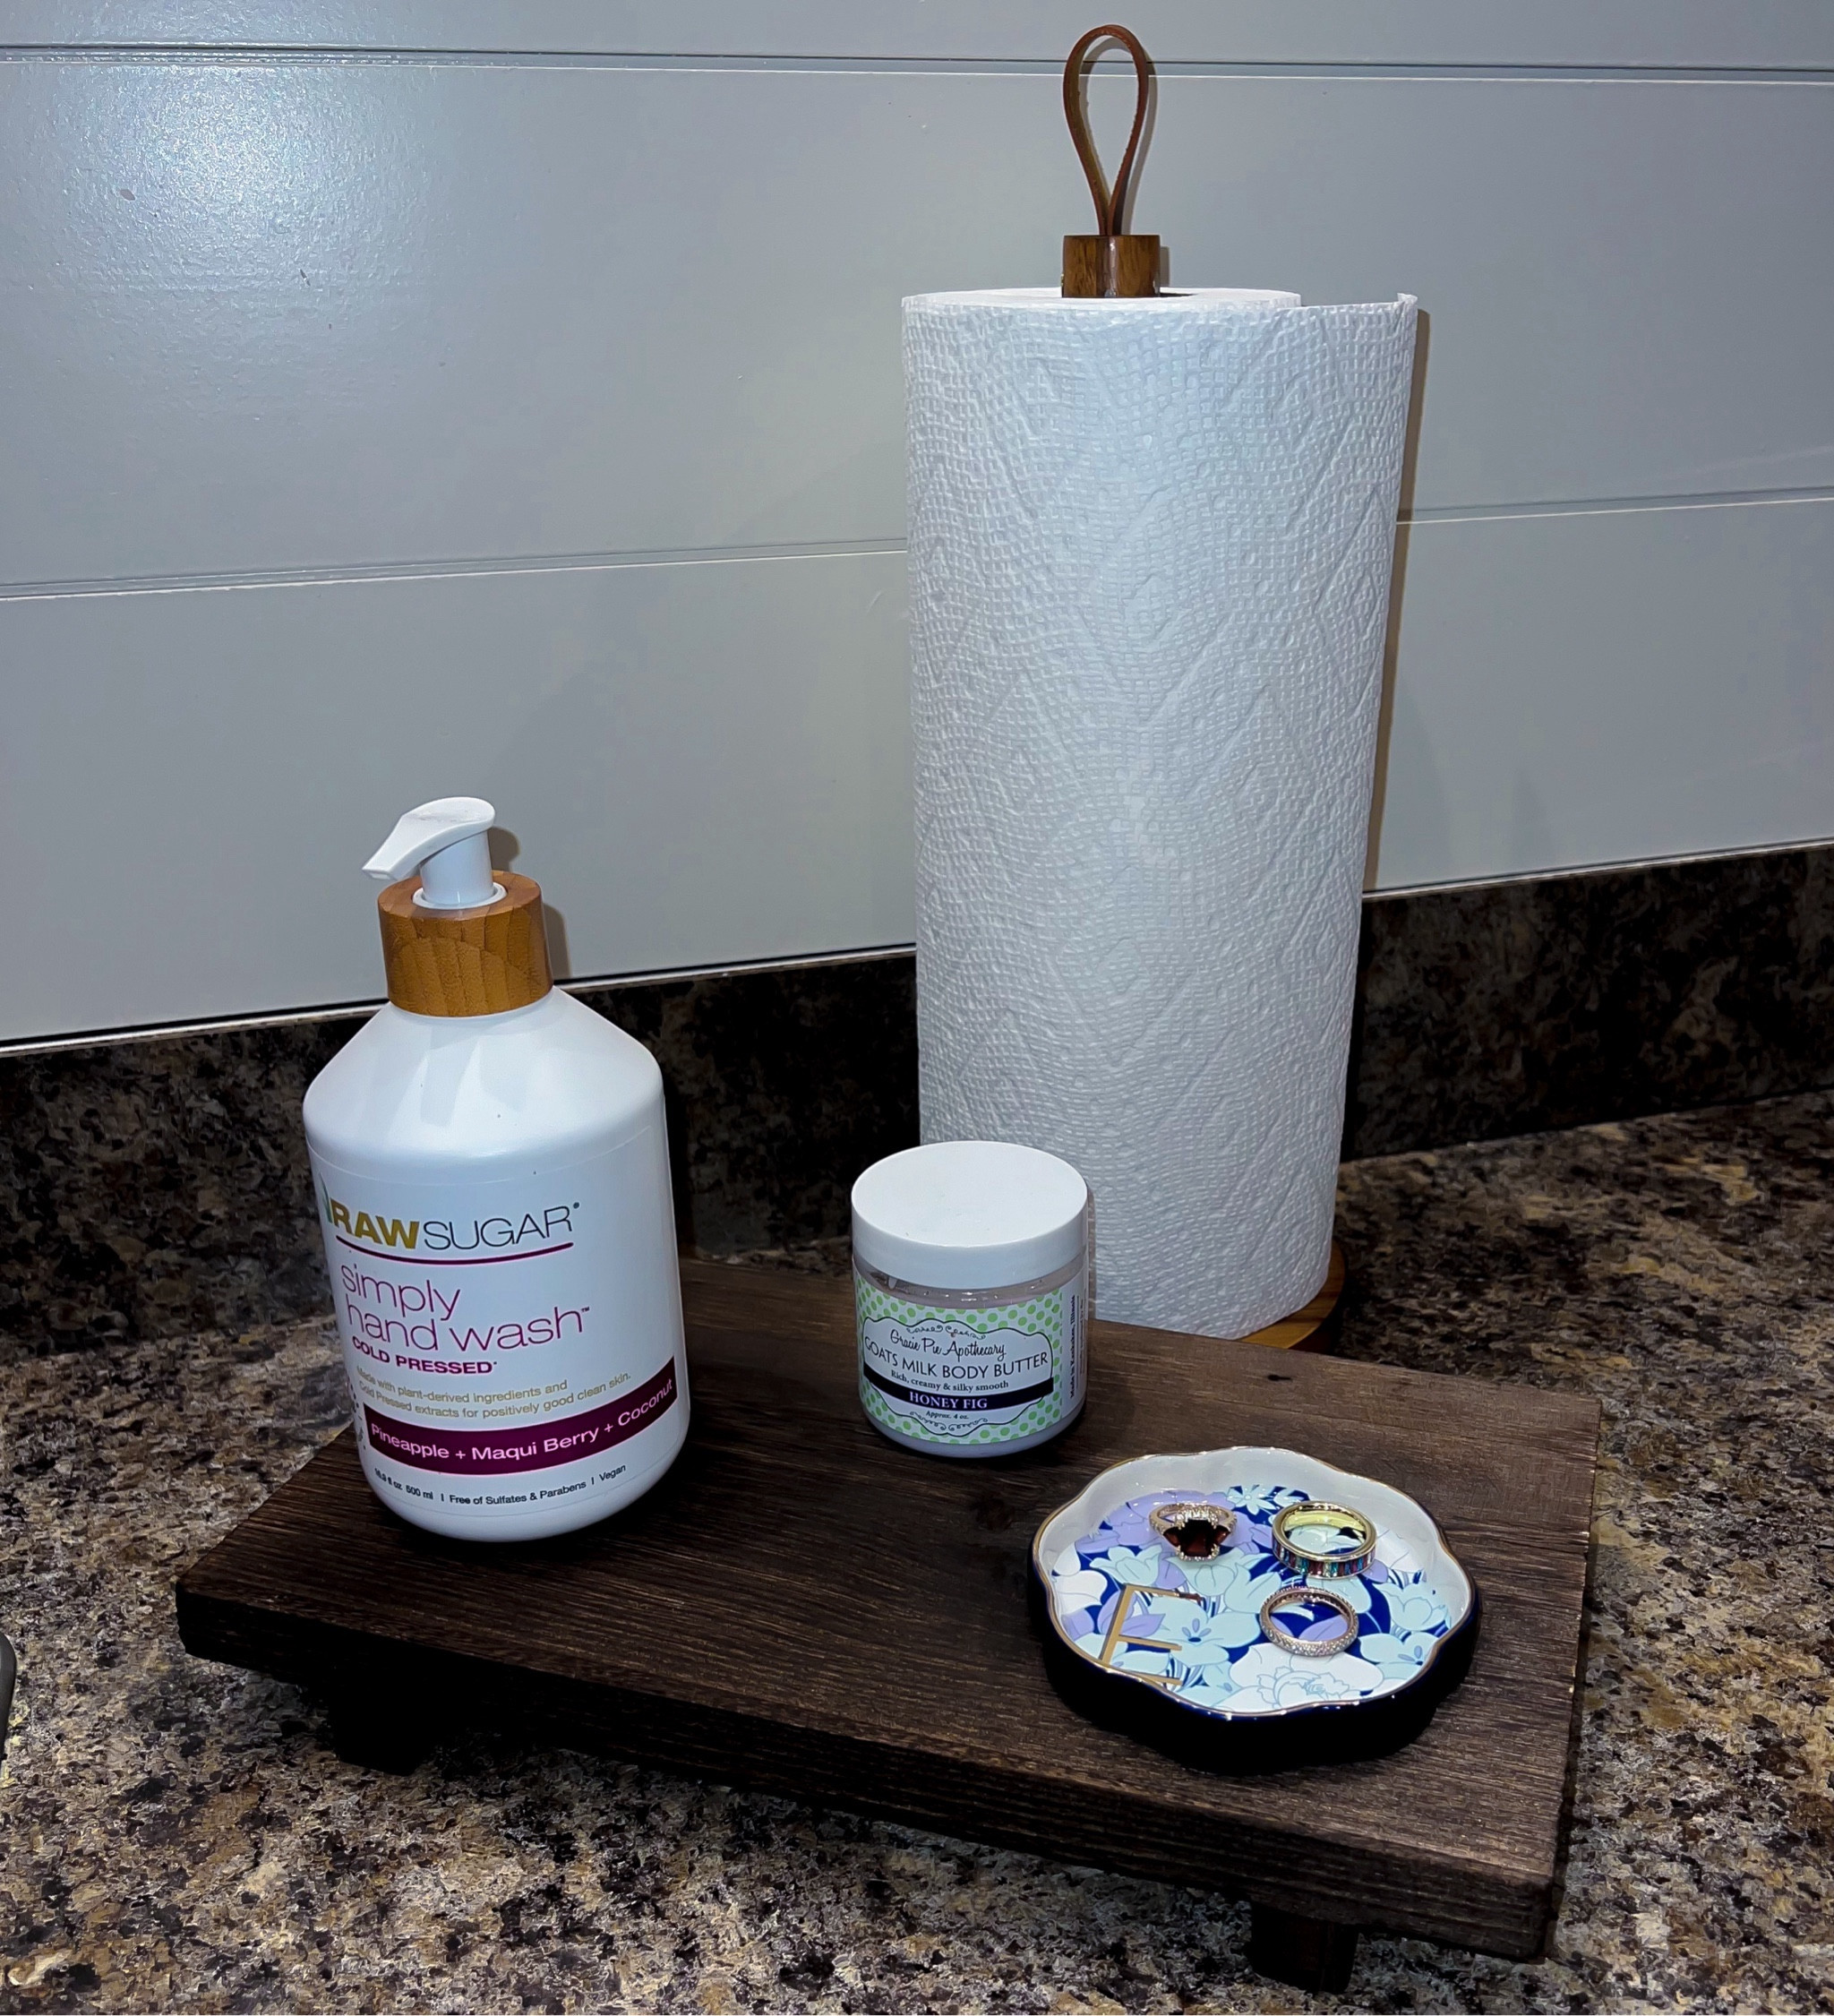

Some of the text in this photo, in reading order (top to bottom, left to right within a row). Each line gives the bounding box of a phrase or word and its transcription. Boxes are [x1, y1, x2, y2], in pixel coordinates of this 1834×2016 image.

[341, 1264, 460, 1321] simply
[346, 1293, 439, 1351] hand
[352, 1335, 390, 1363] COLD
[864, 1335, 1049, 1379] GOATS MILK BODY BUTTER
[890, 1329, 1007, 1362] Gracie Pie Apothecary
[358, 1371, 631, 1419] Cold Pressed extracts for positively good clean skin.
[377, 1377, 396, 1393] with
[398, 1385, 469, 1403] plant-derived
[473, 1386, 542, 1404] ingredients
[544, 1379, 568, 1394] and
[891, 1369, 1009, 1394] Rich, creamy & silky smooth
[909, 1391, 988, 1409] HONEY FIG
[370, 1378, 673, 1461] Pineapple + Maqui Berry + Coconut
[406, 1484, 421, 1497] 500
[423, 1490, 434, 1500] ml
[450, 1495, 471, 1505] Free
[473, 1496, 484, 1505] of
[485, 1493, 527, 1505] Sulfates
[529, 1492, 538, 1501] &
[539, 1481, 587, 1499] Parabens
[598, 1463, 626, 1482] Vegan
